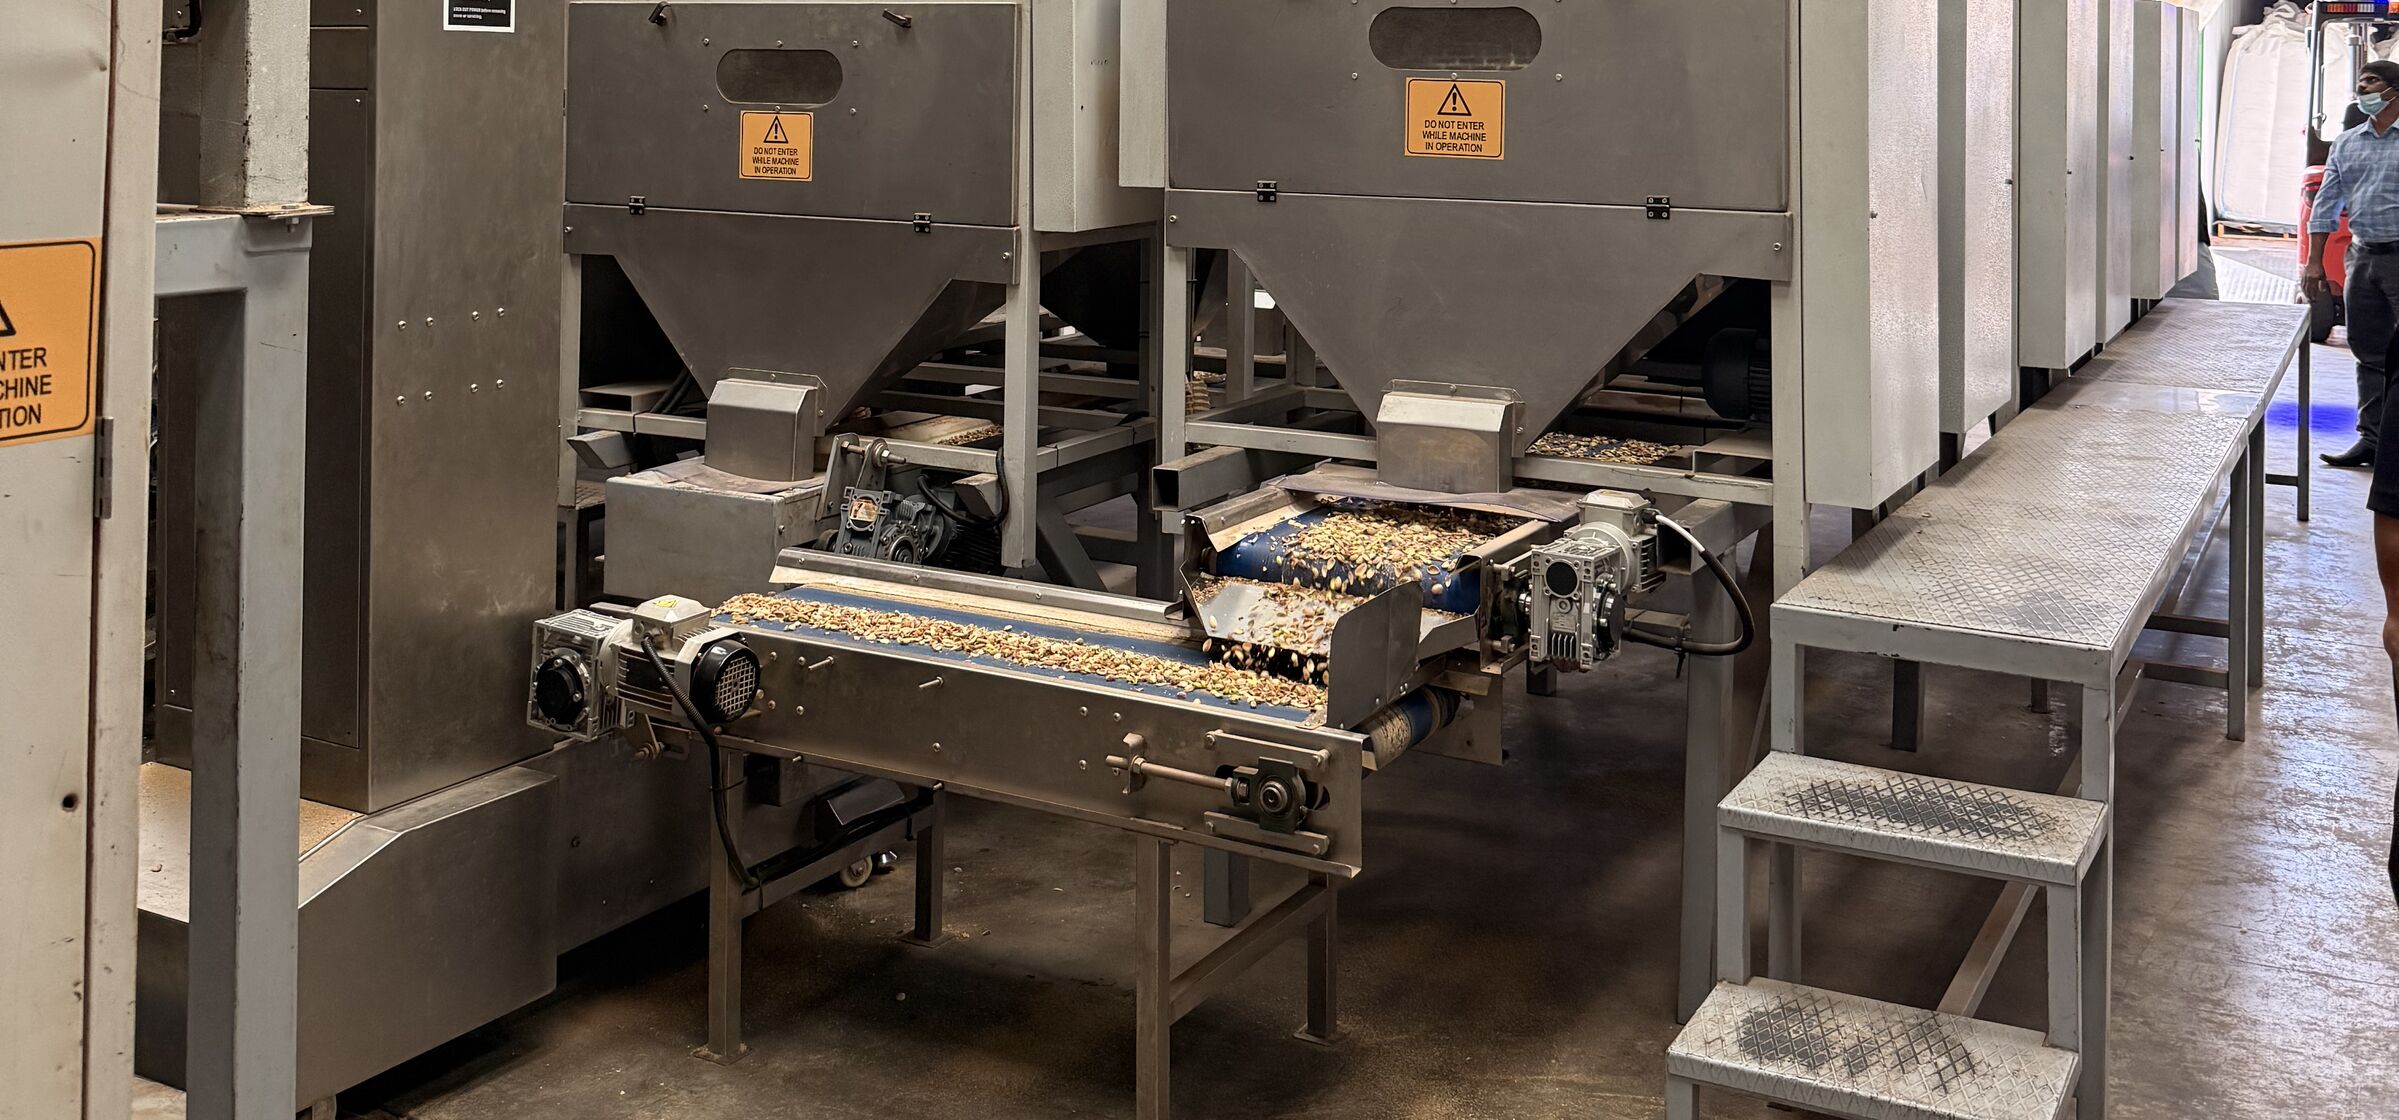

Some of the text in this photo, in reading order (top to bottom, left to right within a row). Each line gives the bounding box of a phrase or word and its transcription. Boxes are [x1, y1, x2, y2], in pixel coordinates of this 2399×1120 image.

[1424, 120, 1484, 130] DO NOT ENTER
[1422, 130, 1486, 142] WHILE MACHINE
[754, 146, 763, 154] DO
[1425, 142, 1482, 152] IN OPERATION
[752, 156, 799, 166] WHILE MACHINE
[762, 166, 796, 175] OPERATION
